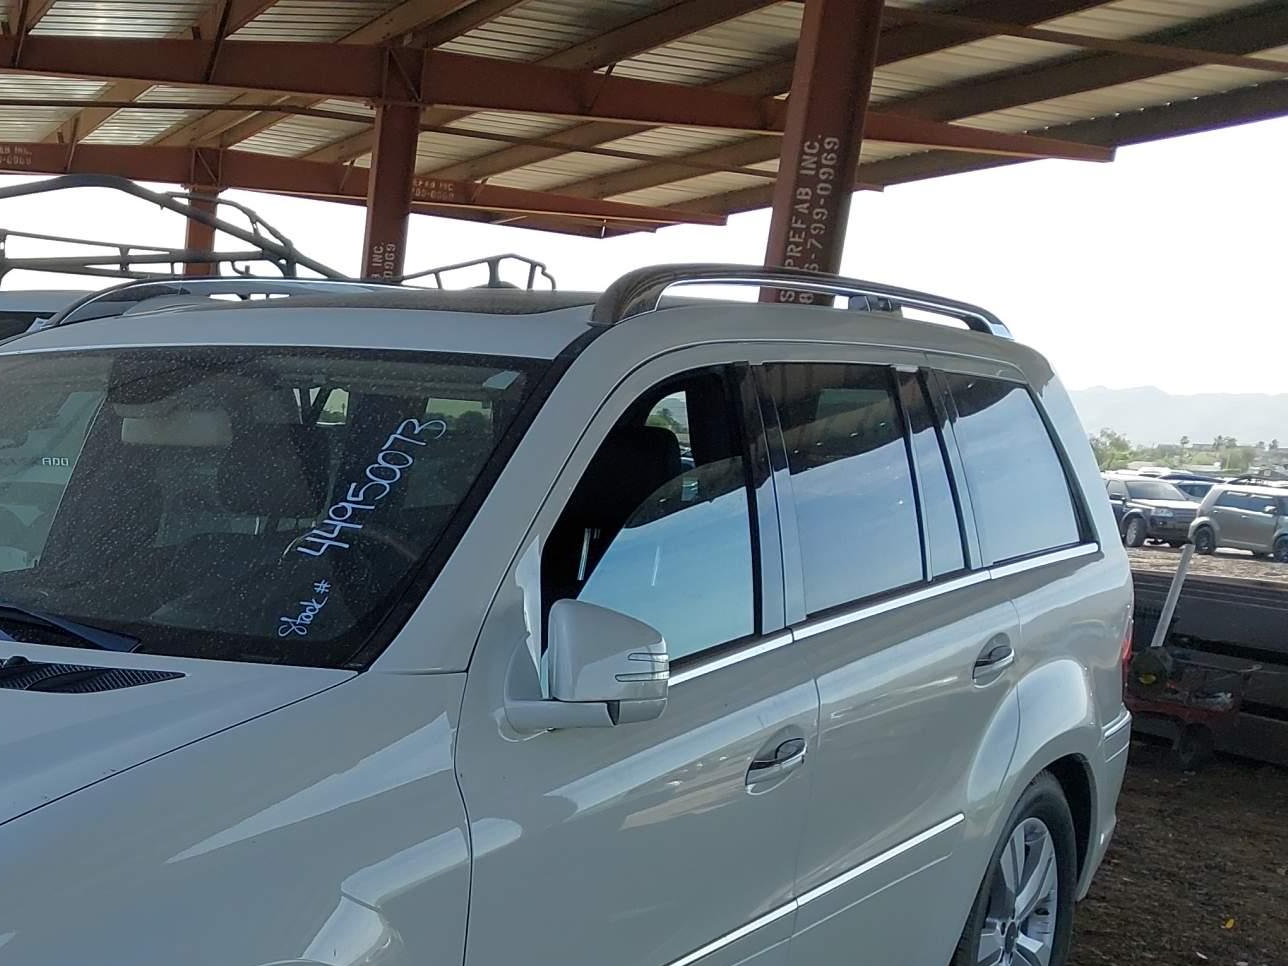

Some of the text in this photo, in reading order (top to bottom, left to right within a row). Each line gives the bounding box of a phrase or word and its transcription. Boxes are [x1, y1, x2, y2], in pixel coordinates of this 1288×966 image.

[800, 133, 823, 176] INC.
[297, 418, 447, 556] 44950073
[314, 579, 331, 594] #
